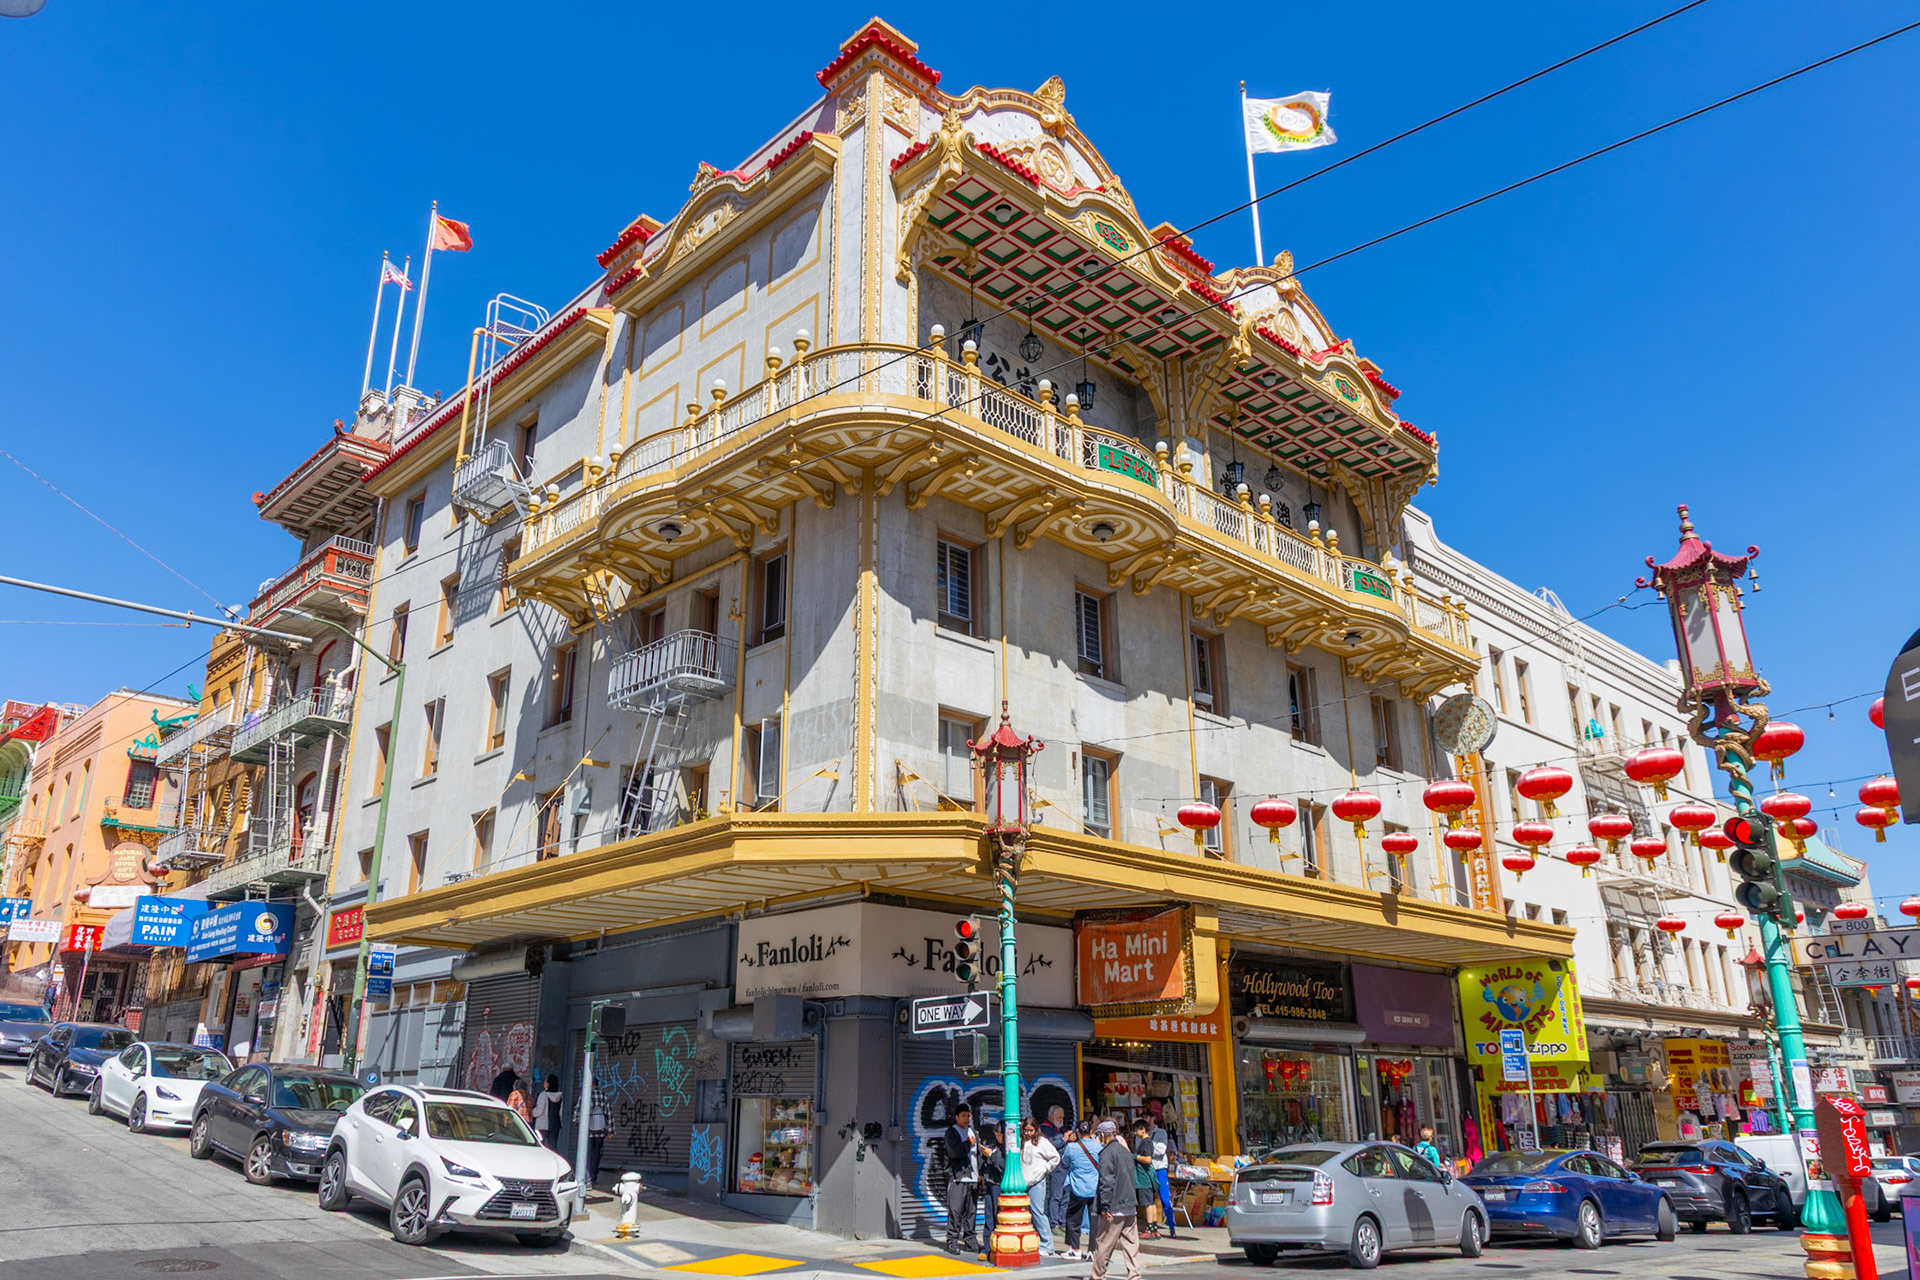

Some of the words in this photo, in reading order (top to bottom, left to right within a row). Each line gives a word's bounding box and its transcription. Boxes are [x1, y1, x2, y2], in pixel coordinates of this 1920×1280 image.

[1098, 222, 1126, 251] 1922
[141, 925, 177, 936] PAIN
[1845, 920, 1869, 931] 800
[756, 934, 824, 967] Fanloli
[1091, 937, 1119, 960] Ha
[1125, 930, 1168, 957] Mini
[1805, 935, 1911, 959] CLAY
[1104, 958, 1154, 983] Mart
[1479, 966, 1524, 987] WORLD
[1525, 971, 1544, 983] OF
[802, 982, 840, 992] fanloli.com
[1241, 972, 1312, 1002] Hollywood
[1312, 981, 1335, 1000] Too
[919, 1007, 941, 1022] ONE
[943, 1003, 966, 1020] WAY
[1528, 1042, 1568, 1056] zippo
